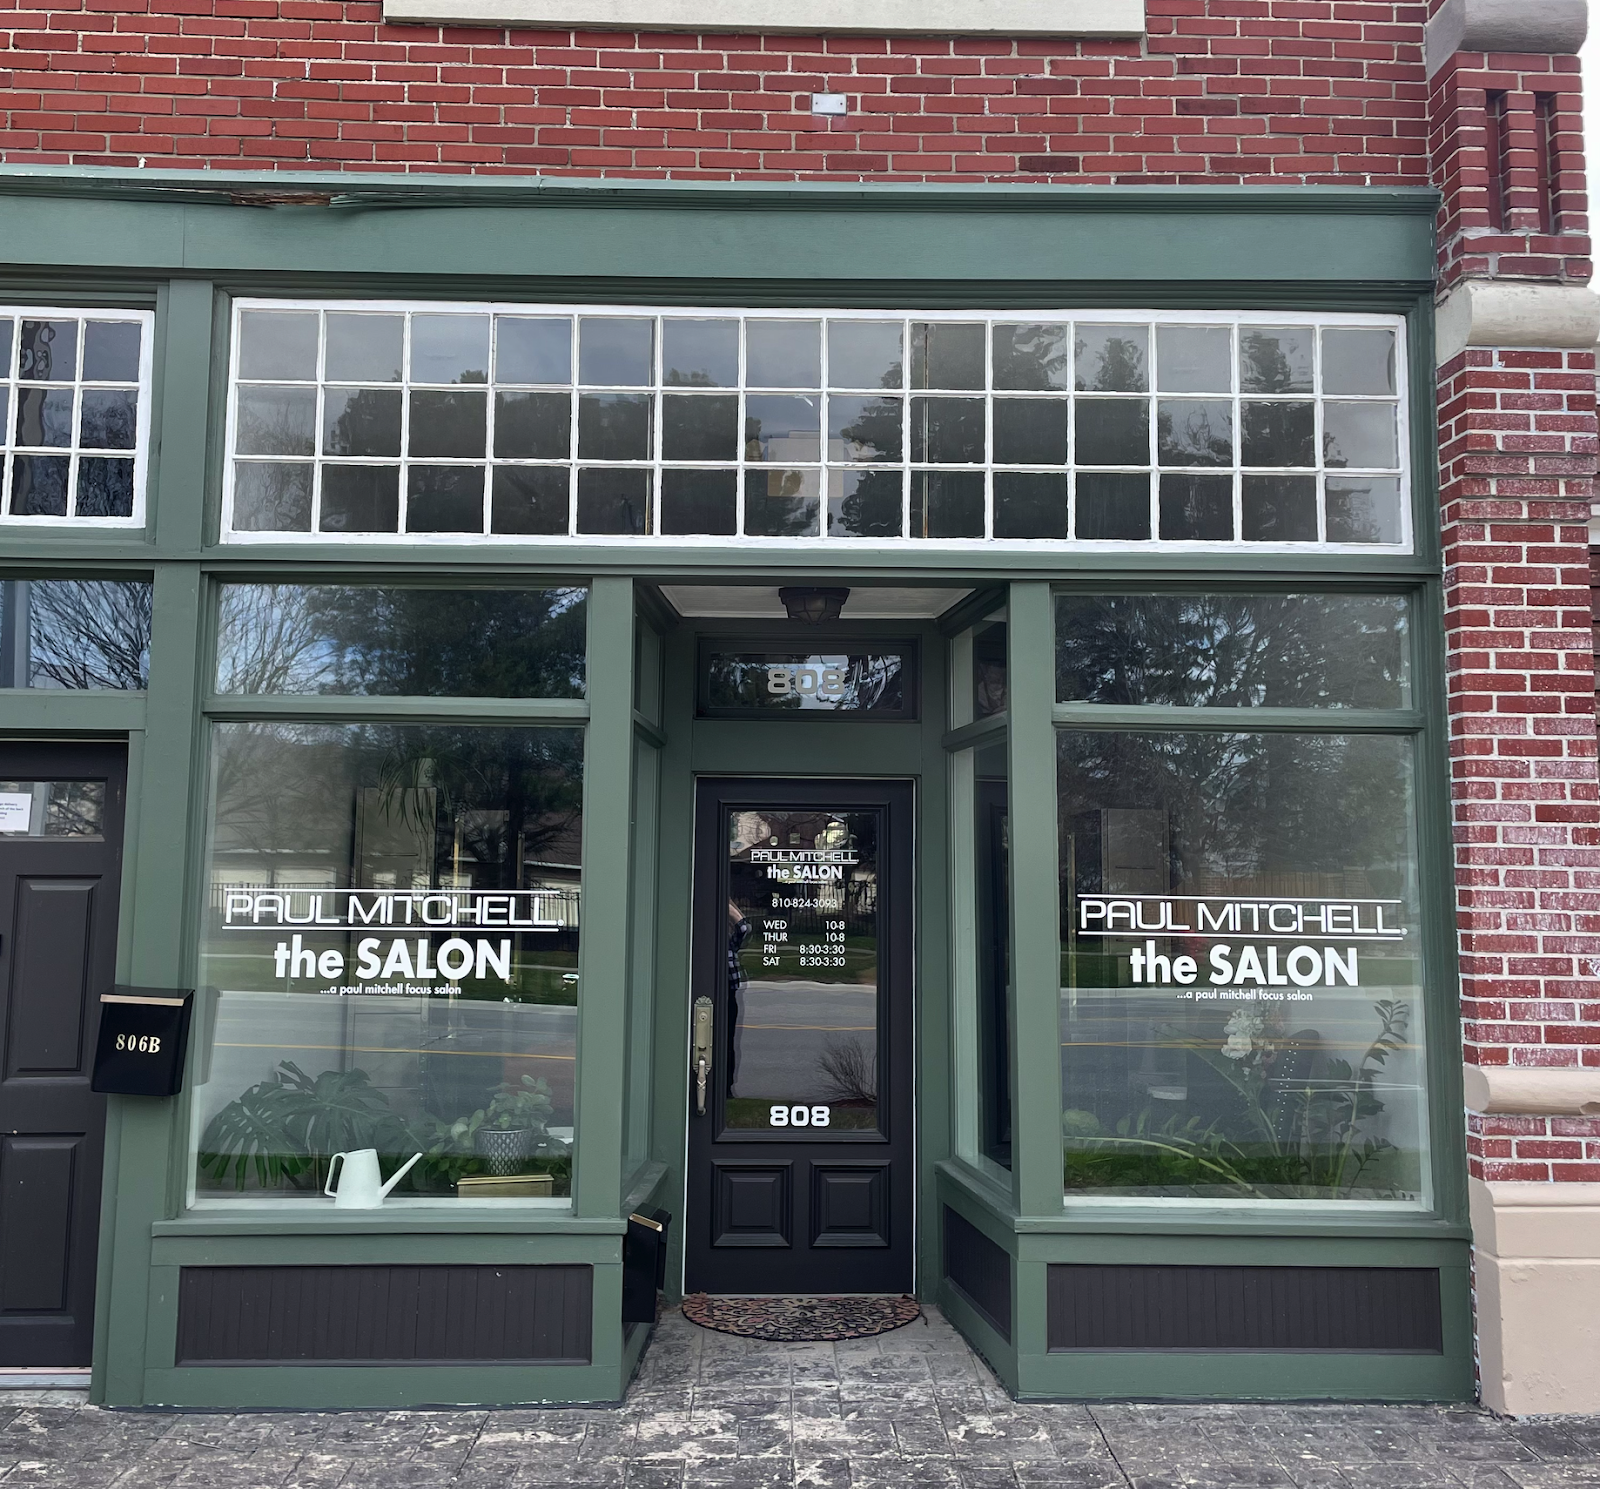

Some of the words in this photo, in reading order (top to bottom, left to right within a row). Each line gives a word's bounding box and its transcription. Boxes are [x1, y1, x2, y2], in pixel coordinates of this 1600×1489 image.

[767, 669, 845, 695] 808
[751, 851, 788, 862] PAUL
[767, 864, 790, 879] the
[793, 864, 843, 880] SALON
[225, 894, 340, 924] PAUL
[771, 898, 837, 909] 810-824-3093
[1080, 900, 1191, 931] PAUL
[763, 920, 788, 930] WED
[825, 920, 846, 931] 10-8
[763, 932, 788, 942] THUR
[825, 932, 846, 943] 10-8
[273, 934, 345, 980] the
[355, 937, 511, 980] SALON
[763, 944, 777, 954] FRI
[799, 944, 846, 955] 8:30-3:30
[762, 956, 781, 966] SAT
[799, 956, 846, 967] 8:30-3:30
[1129, 939, 1198, 985] the
[1209, 944, 1359, 987] SALON
[340, 983, 363, 997] paul
[365, 983, 403, 995] mitchell
[405, 983, 432, 995] focus
[434, 983, 462, 995] salon
[1195, 988, 1217, 1002] paul
[1219, 989, 1257, 1001] mitchell
[1258, 989, 1284, 1001] focus
[1286, 990, 1313, 1001] salon
[116, 1033, 161, 1054] 806B
[769, 1105, 830, 1127] 808
